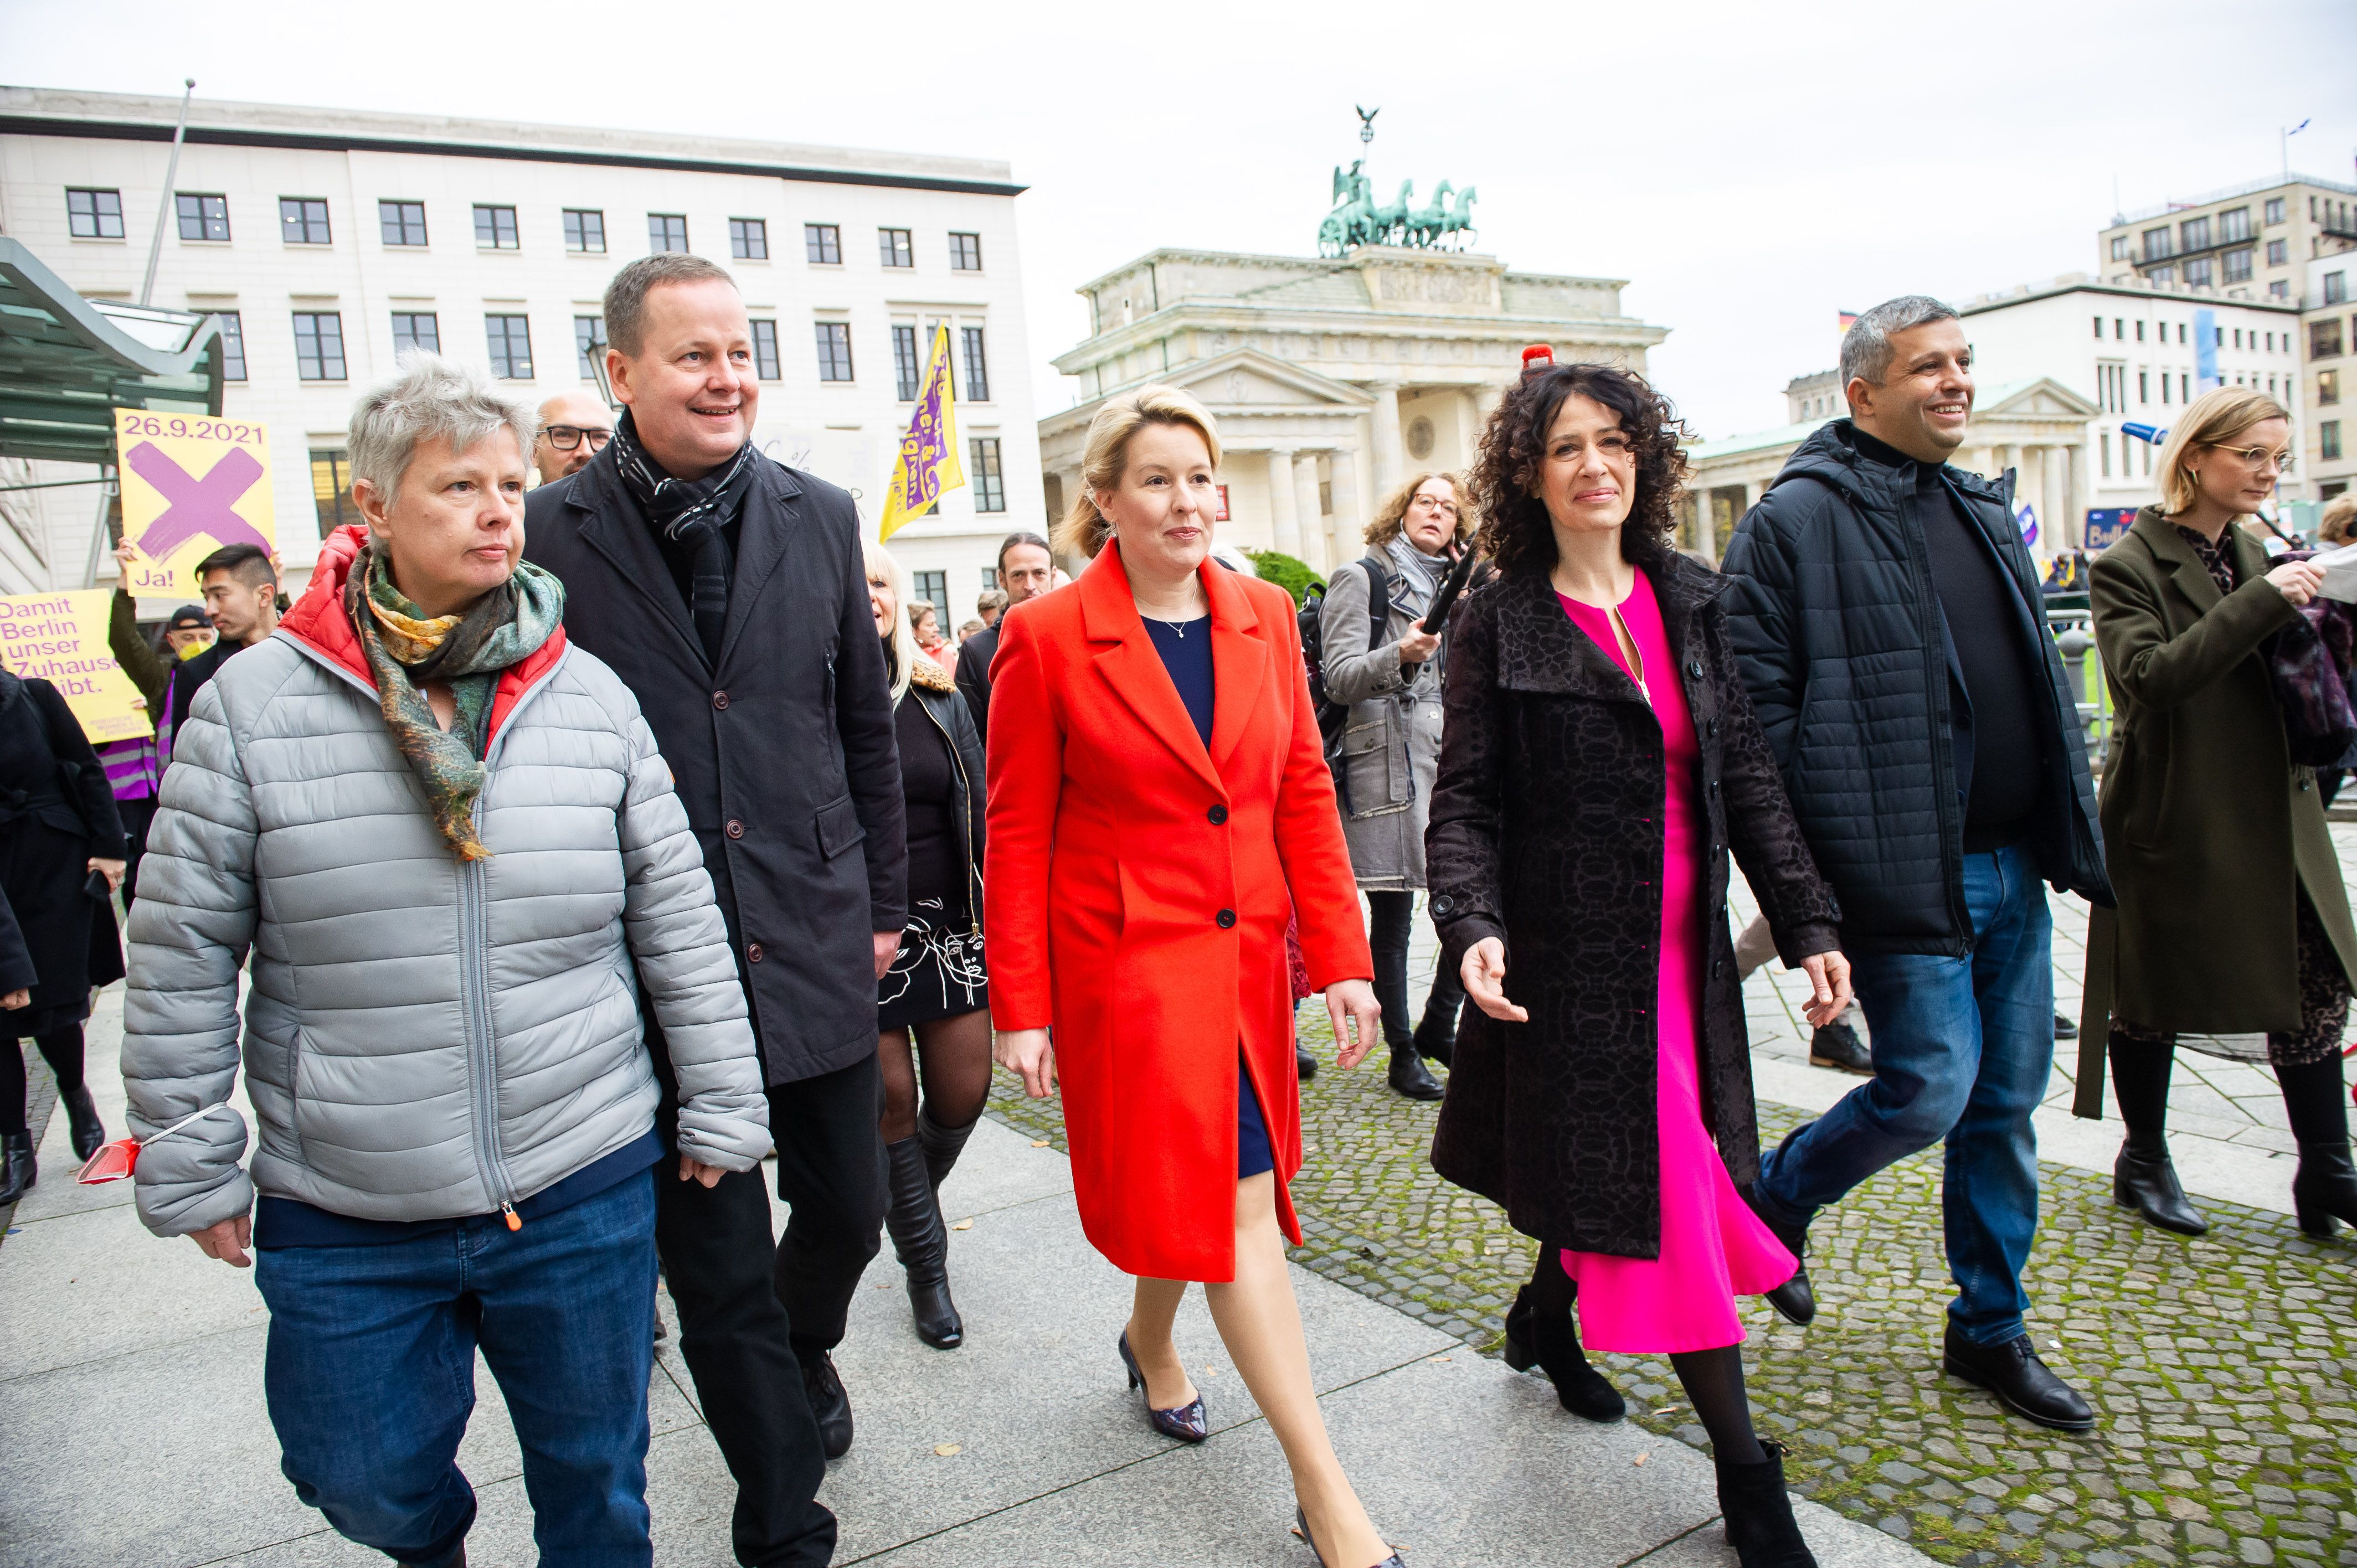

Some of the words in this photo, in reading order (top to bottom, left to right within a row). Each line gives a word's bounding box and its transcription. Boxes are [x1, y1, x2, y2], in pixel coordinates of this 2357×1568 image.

[124, 416, 262, 443] 26.9.2021
[921, 445, 935, 462] &
[925, 465, 937, 497] Co
[135, 570, 173, 587] Ja!
[0, 598, 74, 618] Damit
[1, 619, 77, 639] Berlin
[7, 640, 80, 658] unser
[54, 678, 102, 696] ibt.
